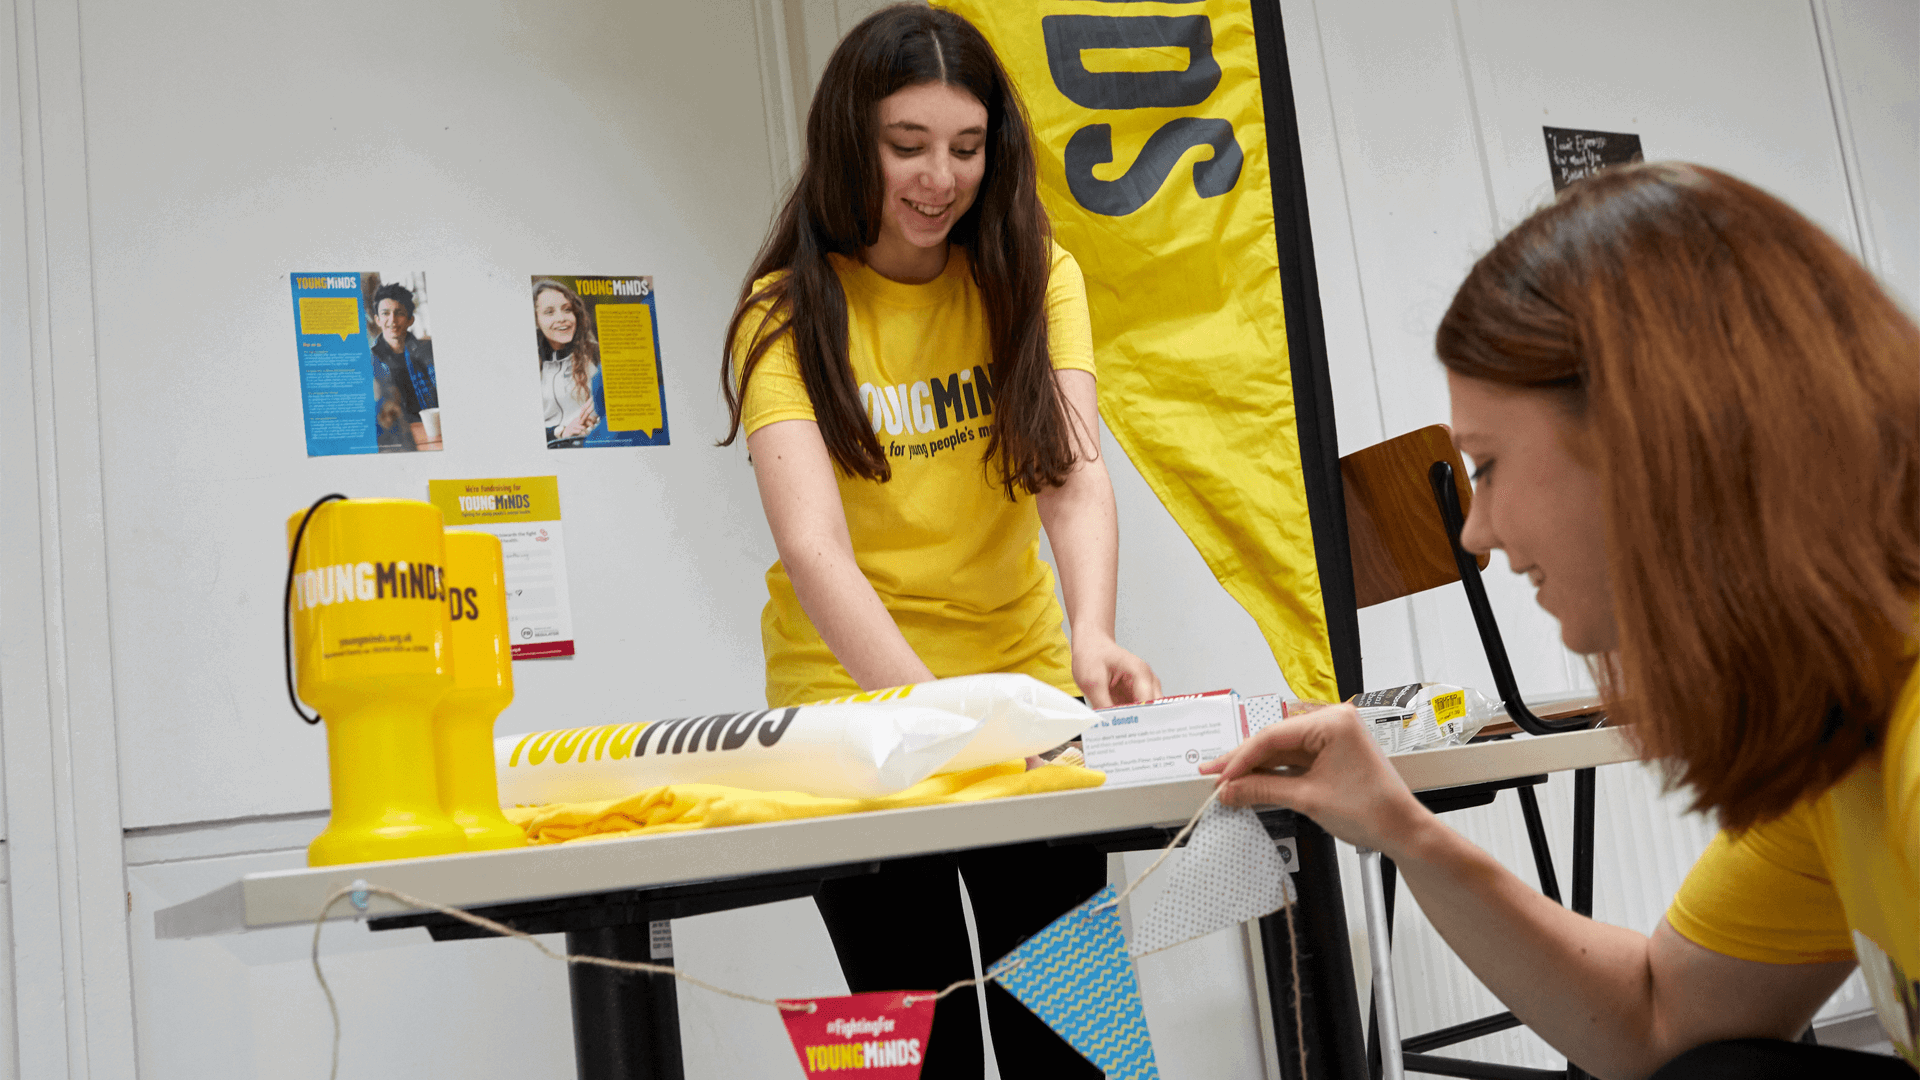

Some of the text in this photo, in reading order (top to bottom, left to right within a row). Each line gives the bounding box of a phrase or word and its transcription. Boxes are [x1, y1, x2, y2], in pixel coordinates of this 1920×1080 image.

[889, 440, 906, 457] for
[929, 426, 975, 458] people's
[1111, 716, 1139, 726] donate
